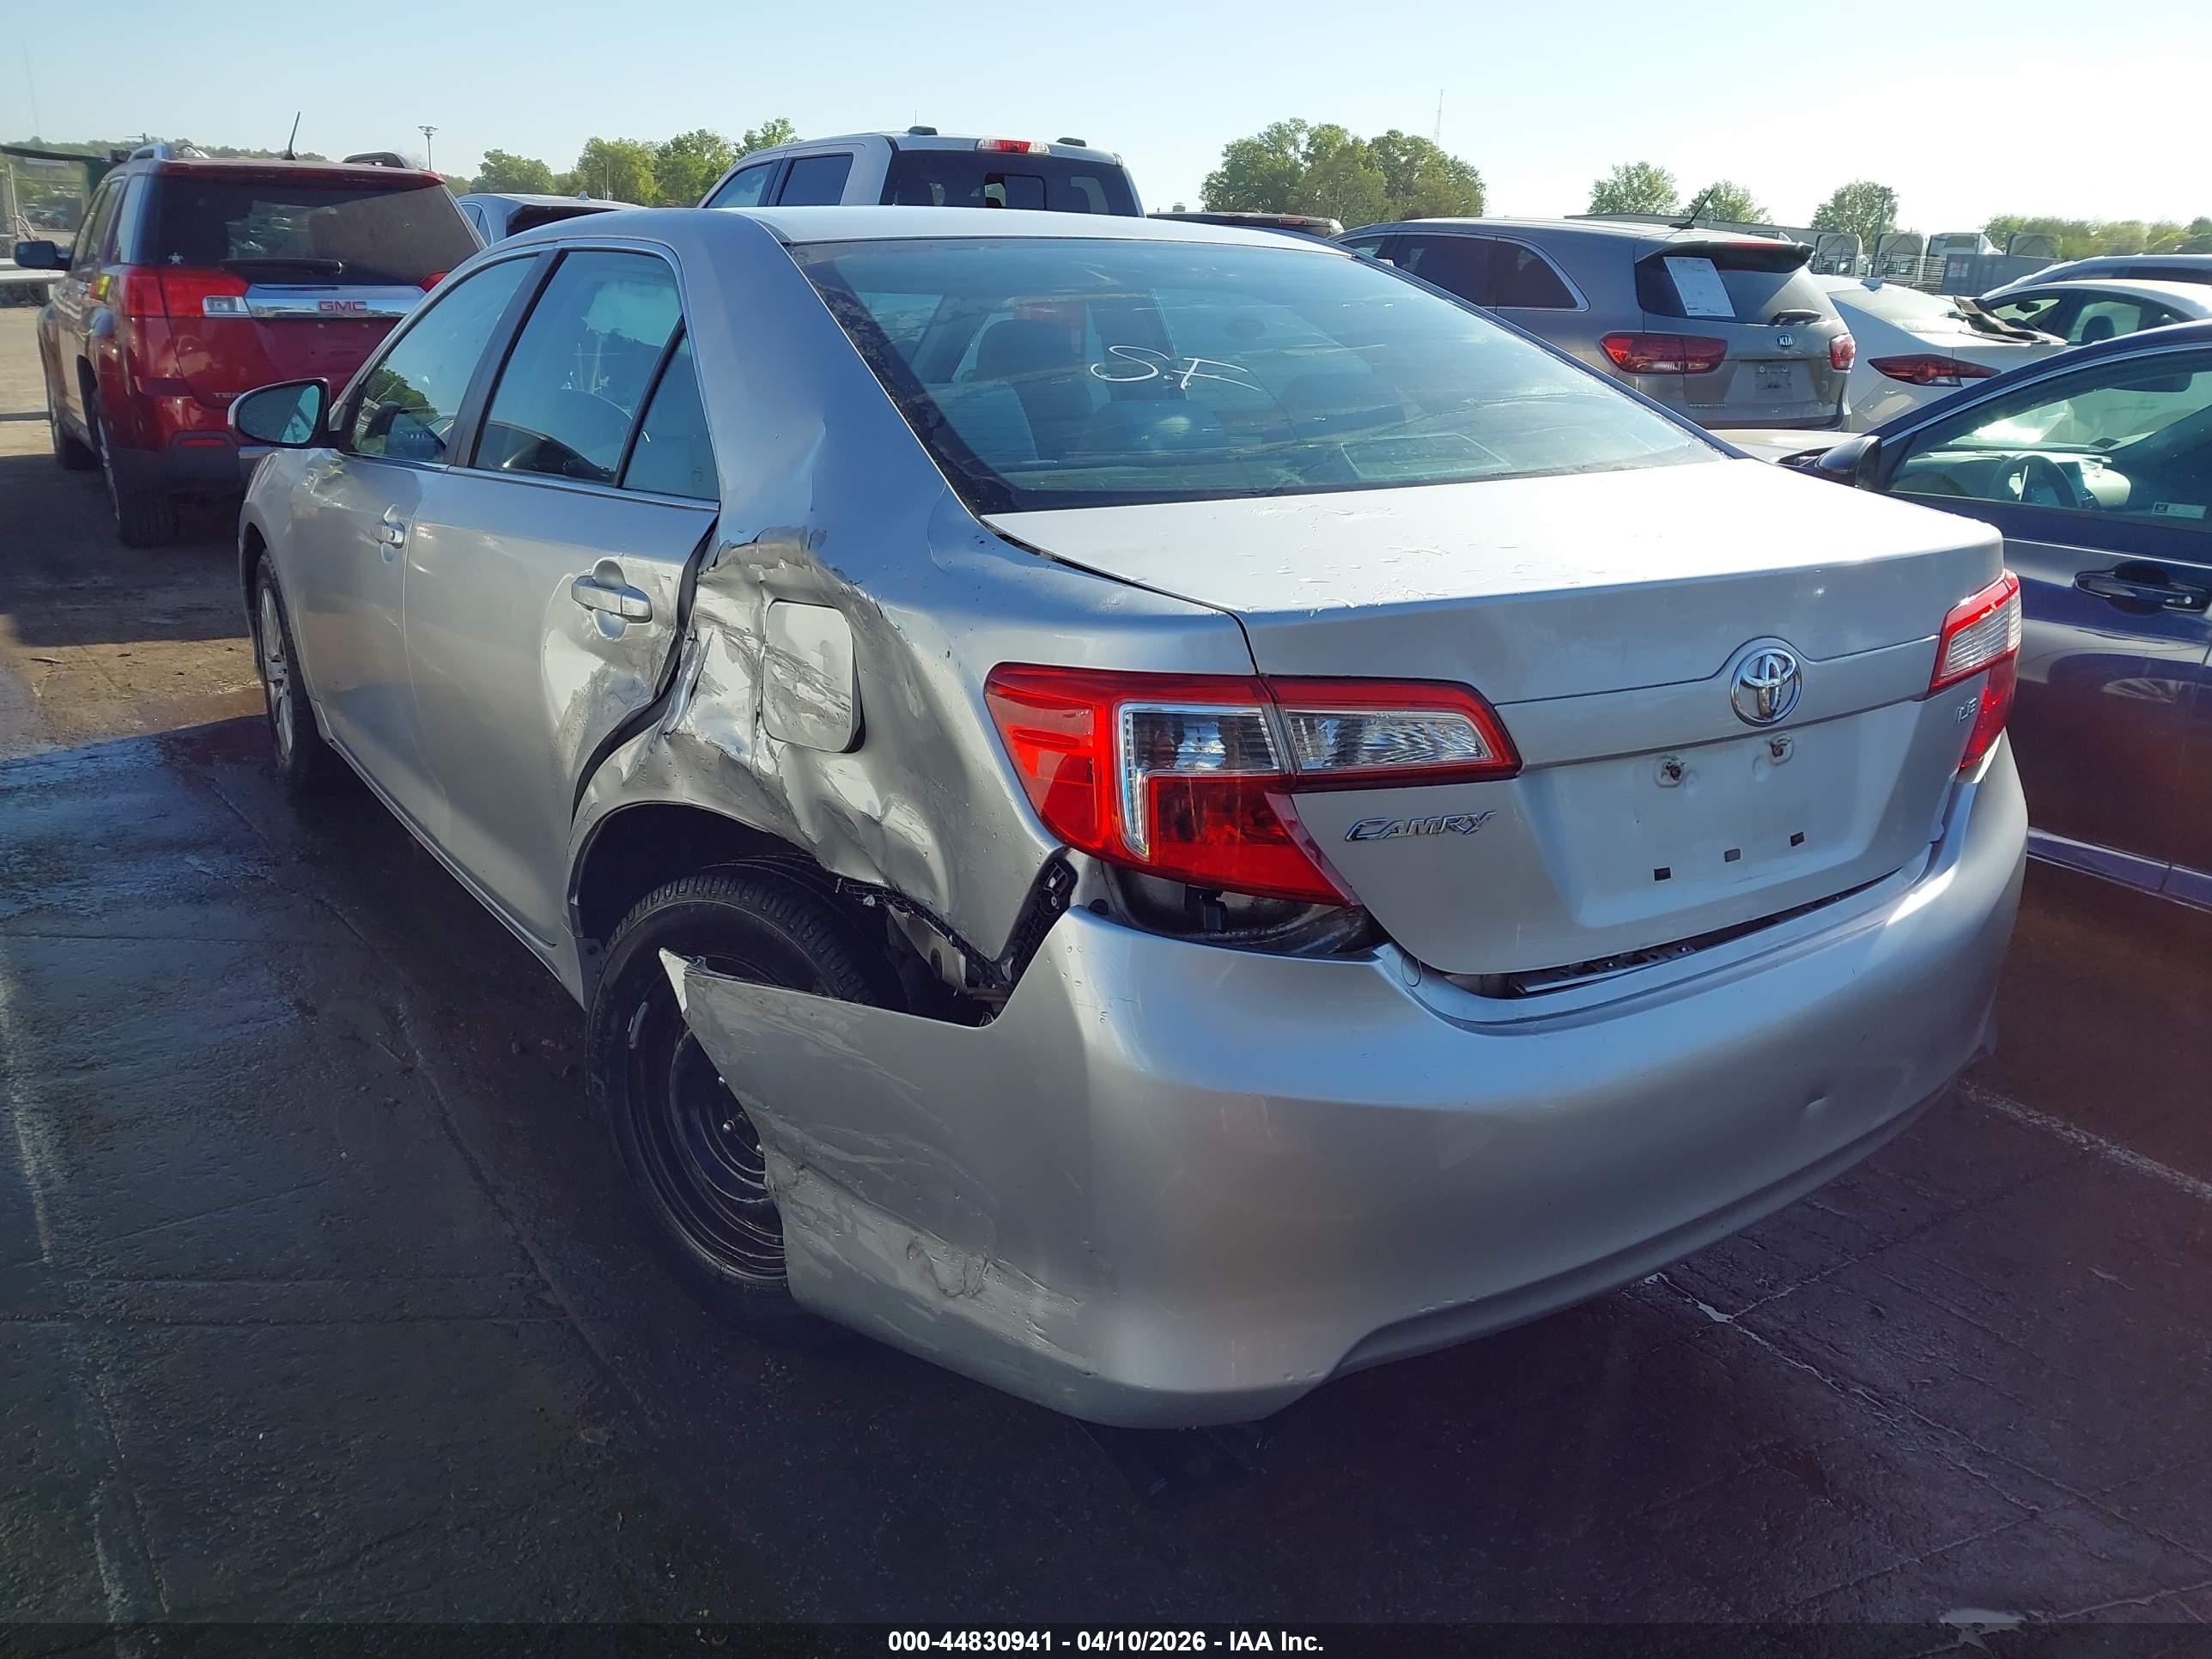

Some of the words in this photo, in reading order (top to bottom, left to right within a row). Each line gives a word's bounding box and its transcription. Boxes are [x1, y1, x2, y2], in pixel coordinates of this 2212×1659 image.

[318, 300, 368, 312] GMC
[1778, 336, 1793, 346] KIA
[1345, 811, 1497, 842] CAMRY
